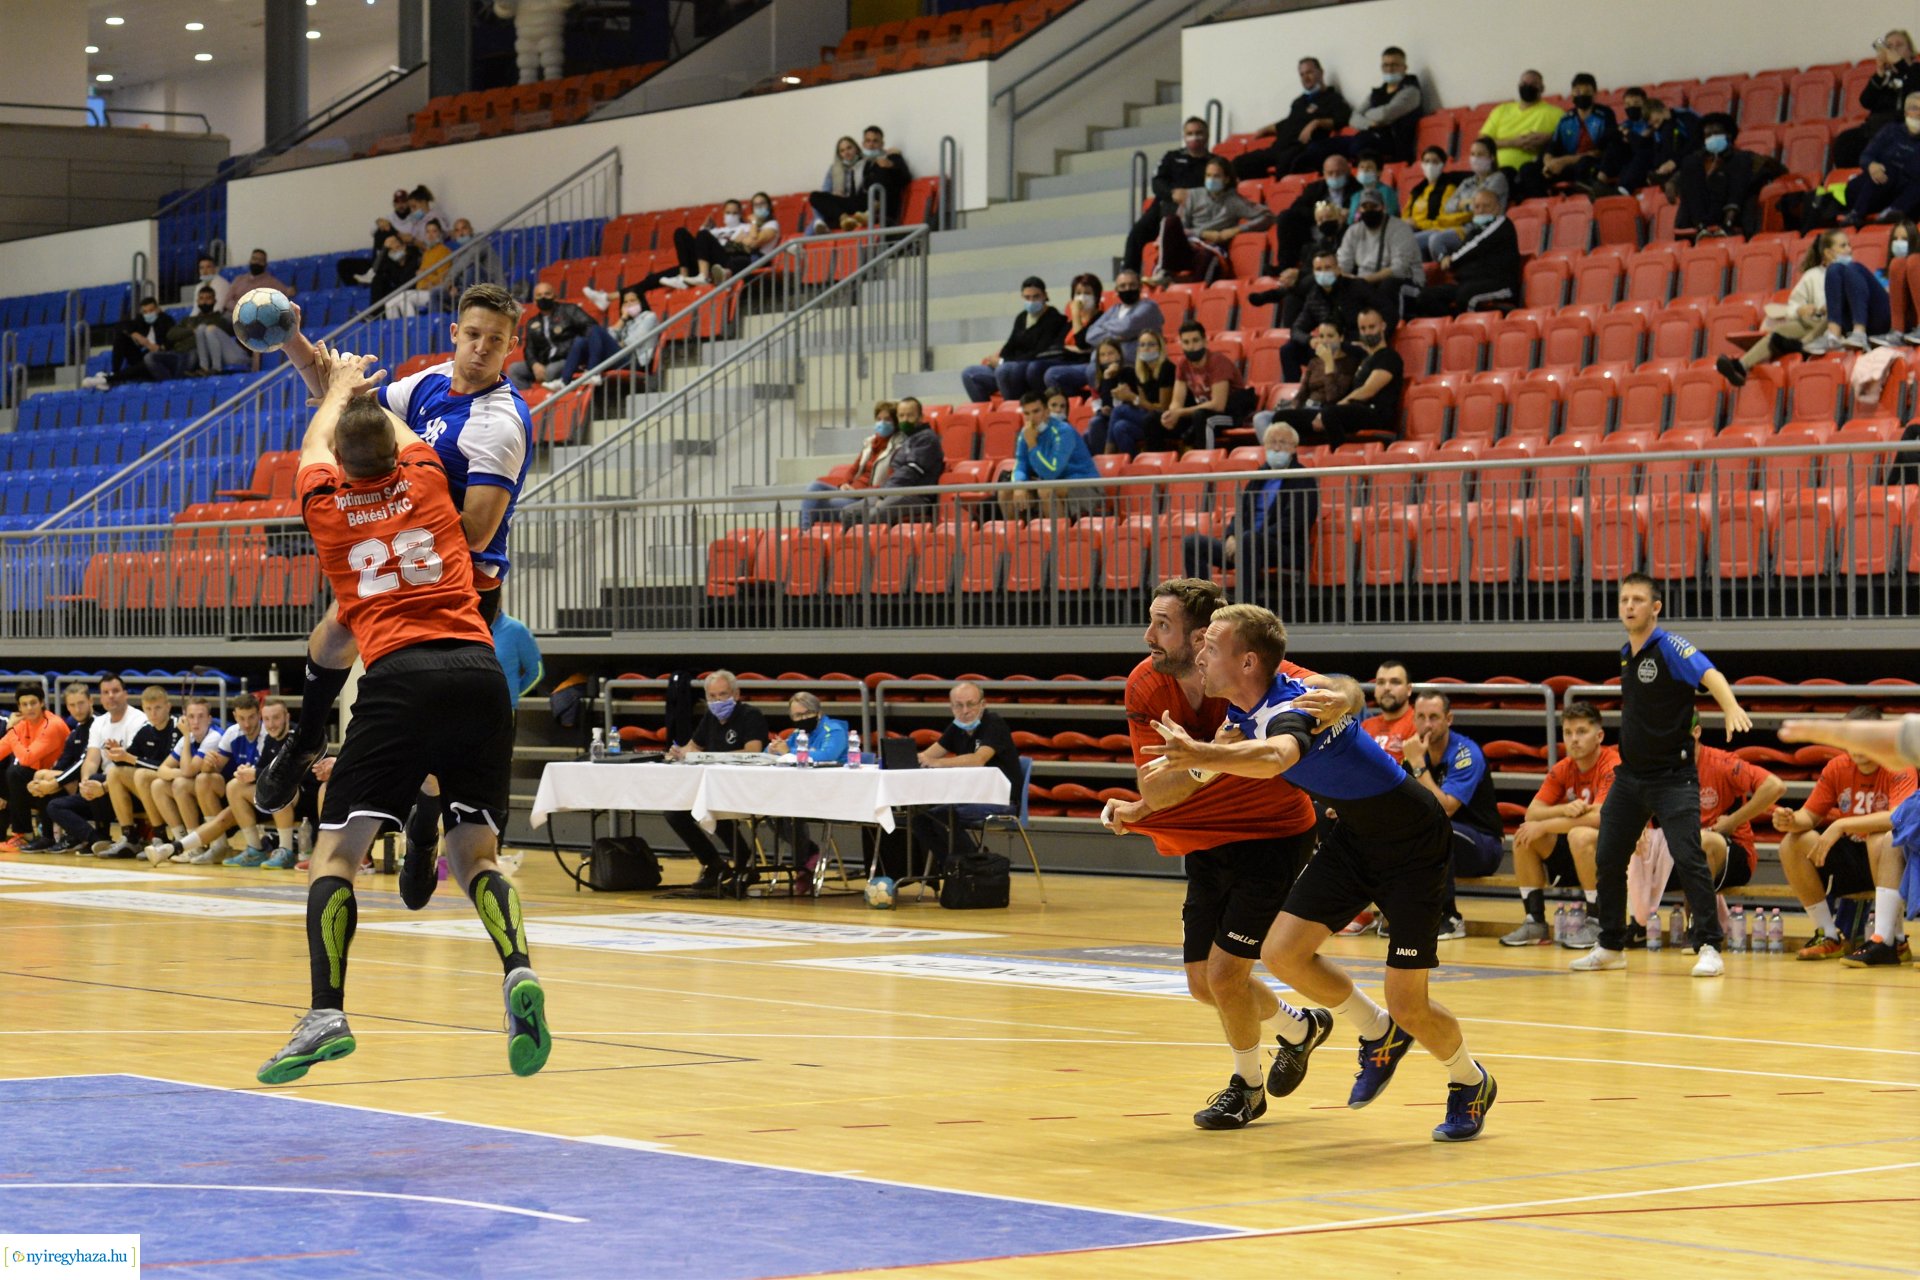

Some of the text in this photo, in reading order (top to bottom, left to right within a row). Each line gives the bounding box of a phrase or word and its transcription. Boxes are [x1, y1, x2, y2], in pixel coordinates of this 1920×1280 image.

[347, 497, 413, 527] Békési FKC
[348, 528, 442, 599] 28
[1395, 947, 1418, 957] JAKO
